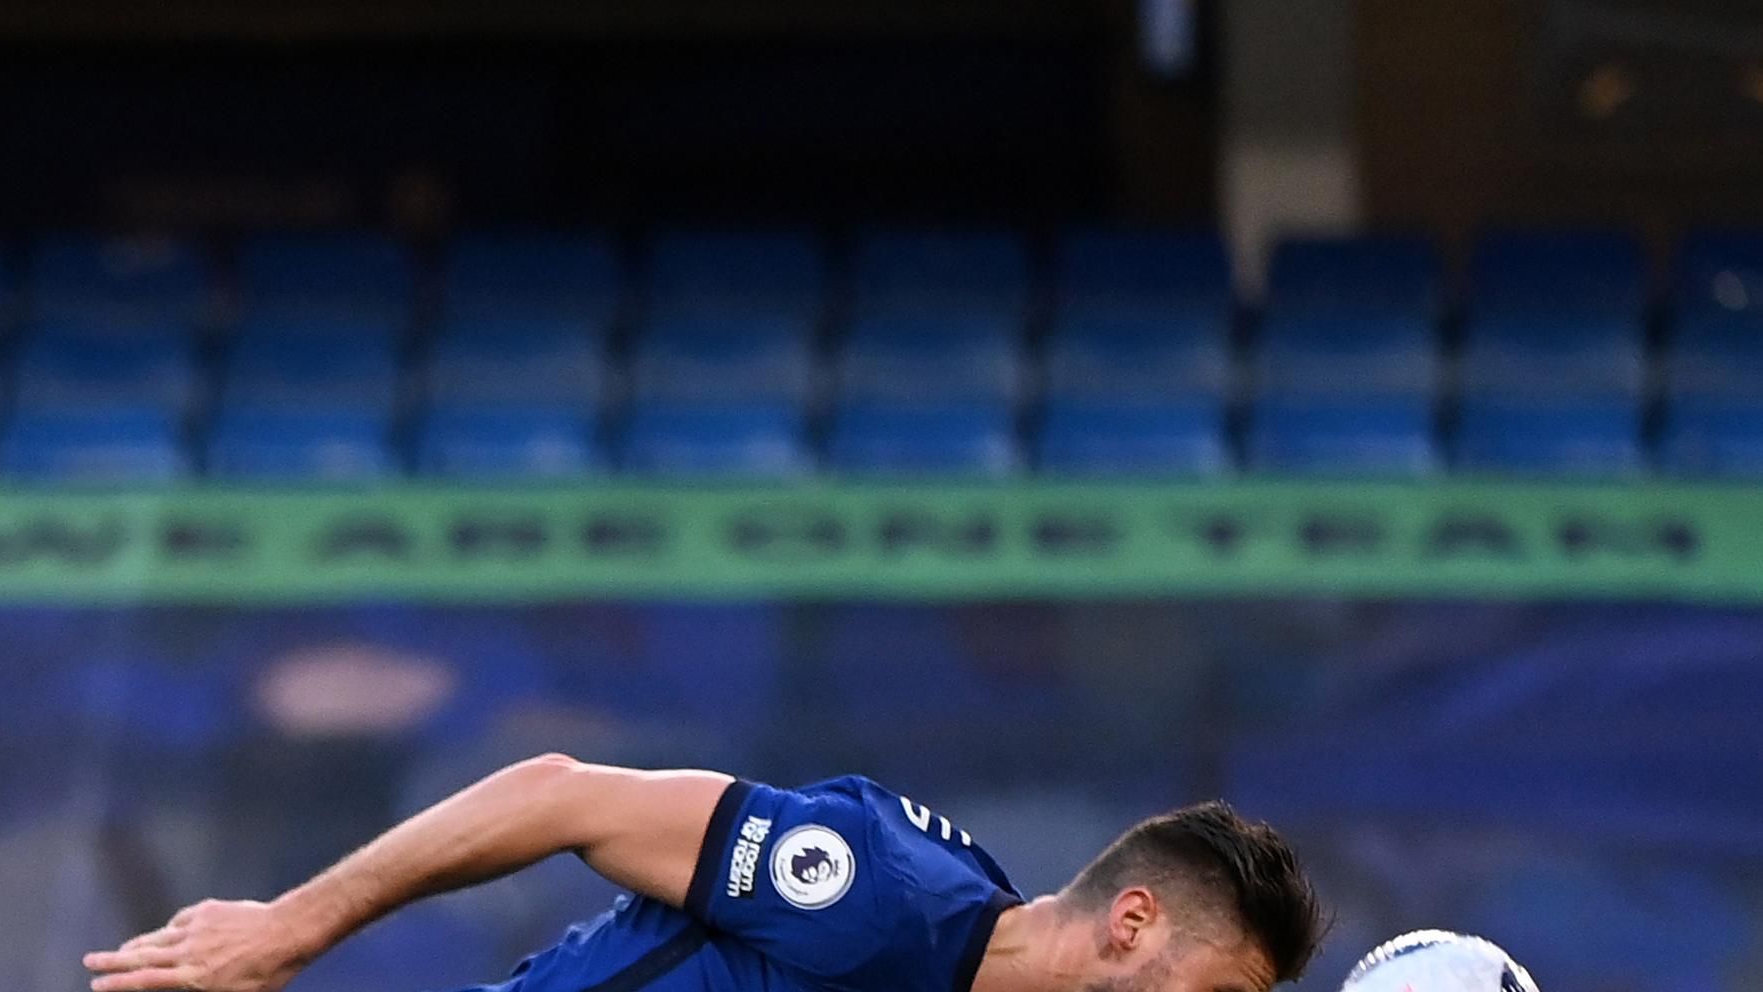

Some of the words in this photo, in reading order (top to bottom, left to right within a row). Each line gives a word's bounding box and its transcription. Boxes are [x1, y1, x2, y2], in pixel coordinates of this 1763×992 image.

[310, 508, 672, 570] ARE
[724, 508, 1122, 570] ONE
[1165, 508, 1704, 572] TEAM
